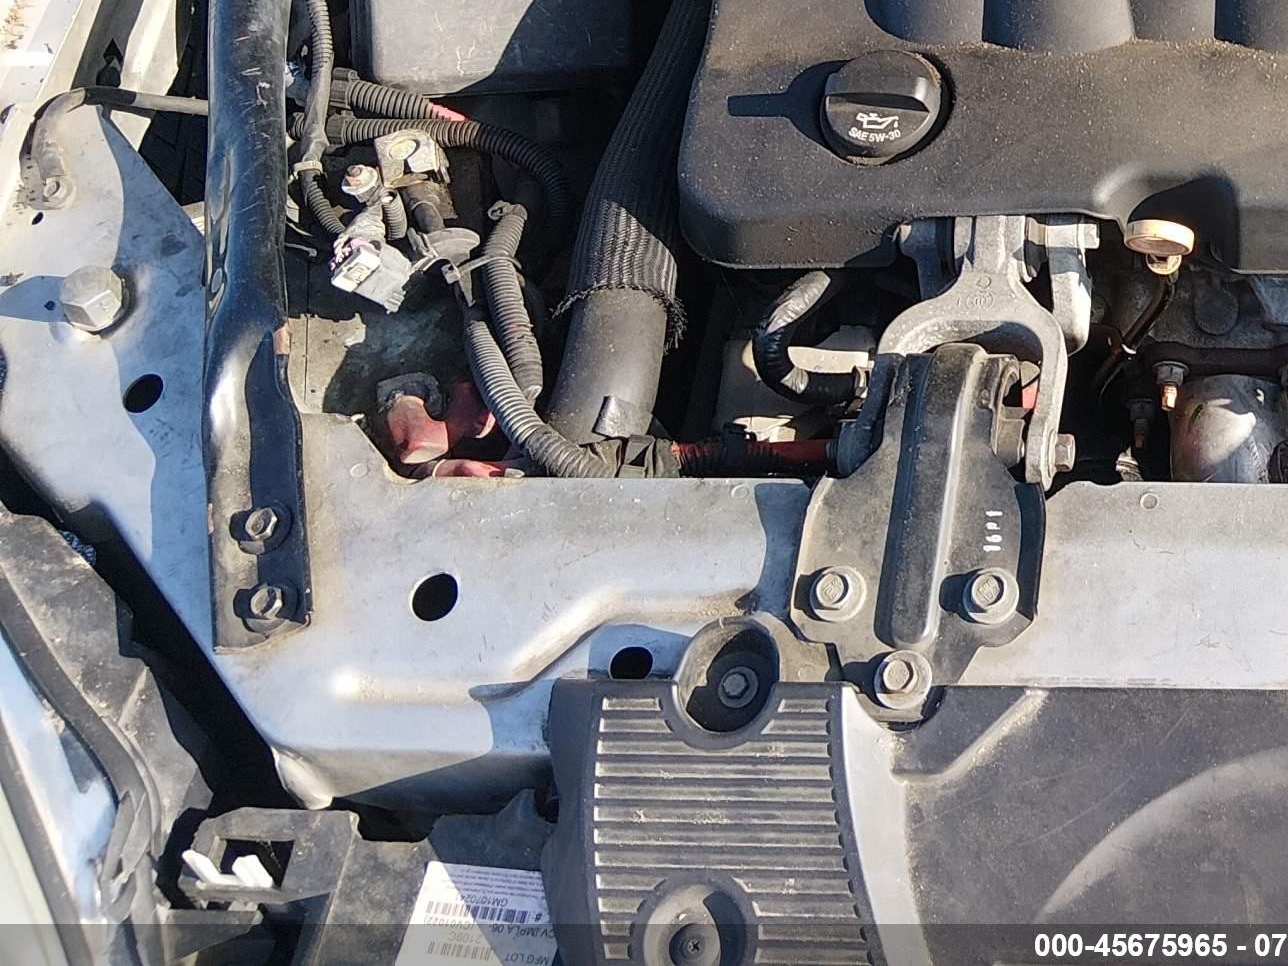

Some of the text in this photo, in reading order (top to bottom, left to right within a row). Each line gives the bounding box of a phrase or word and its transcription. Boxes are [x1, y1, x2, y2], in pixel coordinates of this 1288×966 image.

[848, 126, 901, 142] SAE 5W-30
[503, 952, 550, 966] MFG LOT
